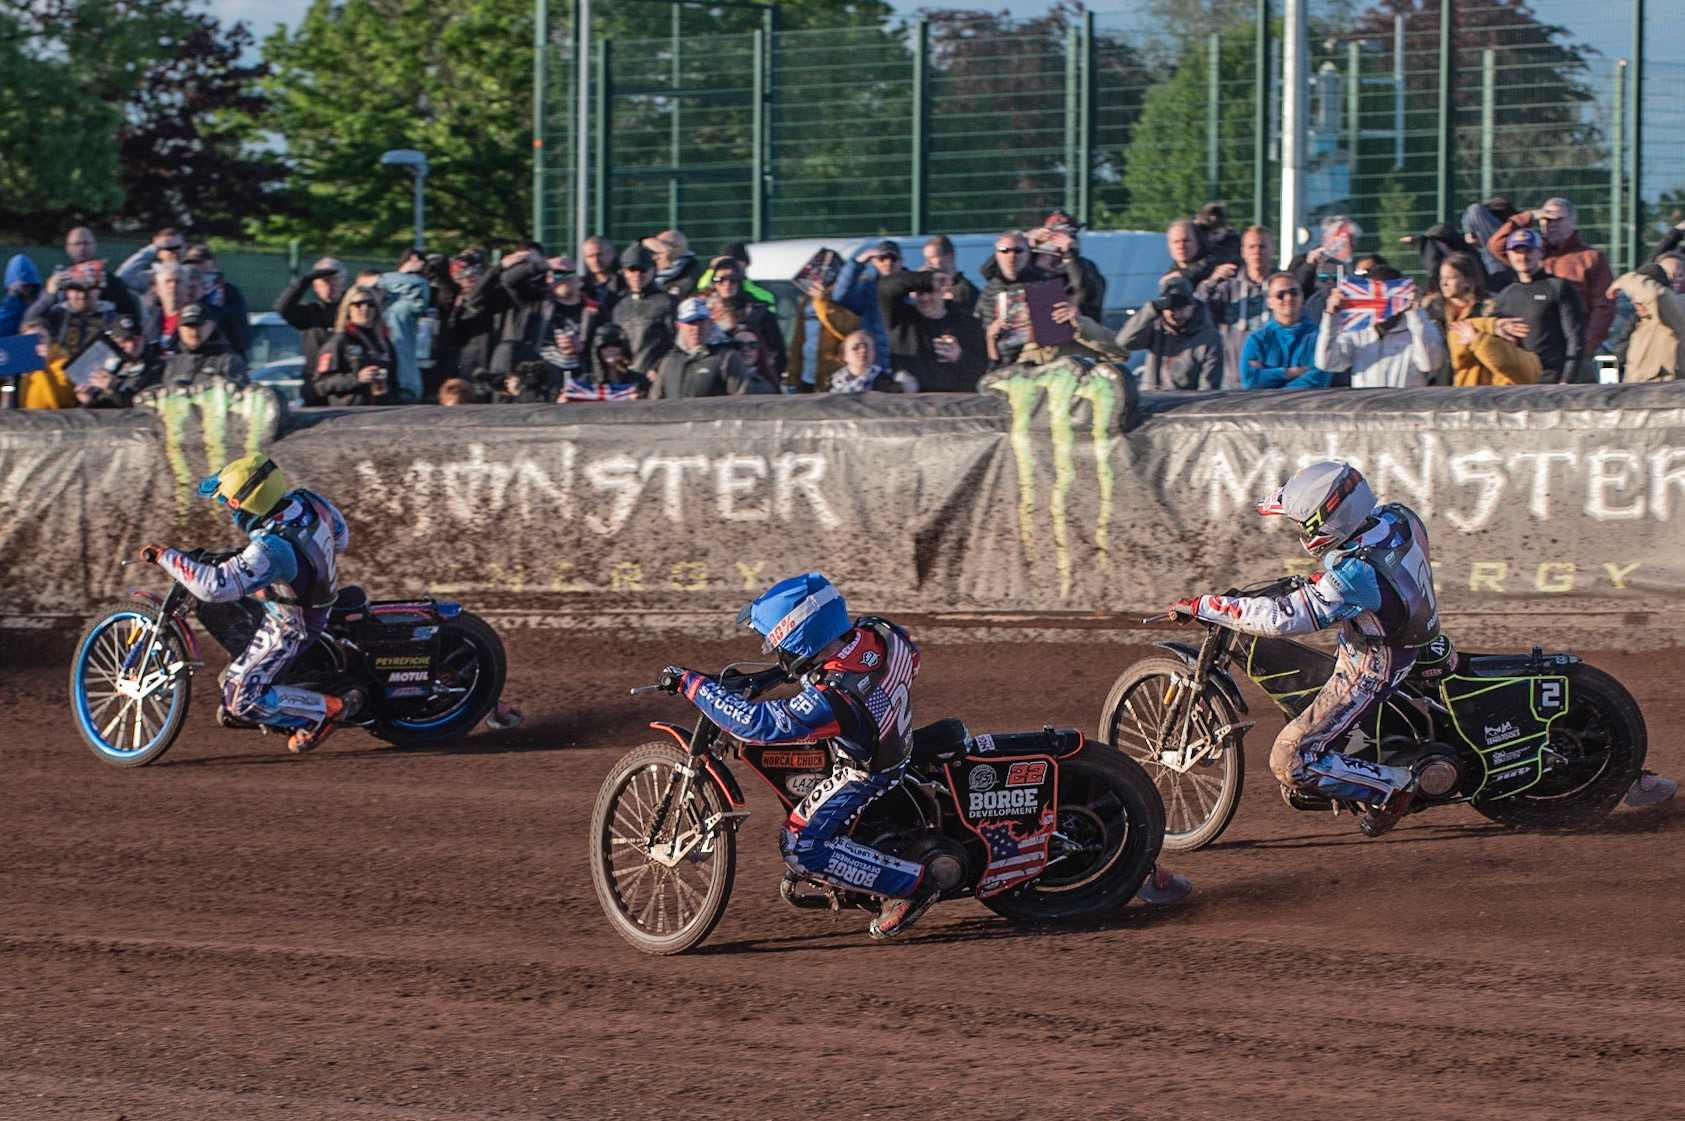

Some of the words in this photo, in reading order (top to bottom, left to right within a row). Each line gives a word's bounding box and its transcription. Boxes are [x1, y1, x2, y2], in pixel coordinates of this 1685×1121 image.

[1198, 432, 1685, 536] MNSTE
[1283, 556, 1641, 594] ERGY
[375, 656, 431, 666] PEYREFICHE
[388, 671, 429, 683] MOTUL
[1542, 682, 1560, 707] 2
[890, 683, 911, 737] 2
[763, 755, 795, 767] NORCAL
[797, 755, 824, 767] CHUCK
[1007, 762, 1047, 786] 22
[969, 788, 1038, 811] BORGE
[969, 806, 1038, 819] DEVELOPMENT
[823, 858, 878, 888] BORGE
[831, 851, 881, 874] DEVELOPMENT
